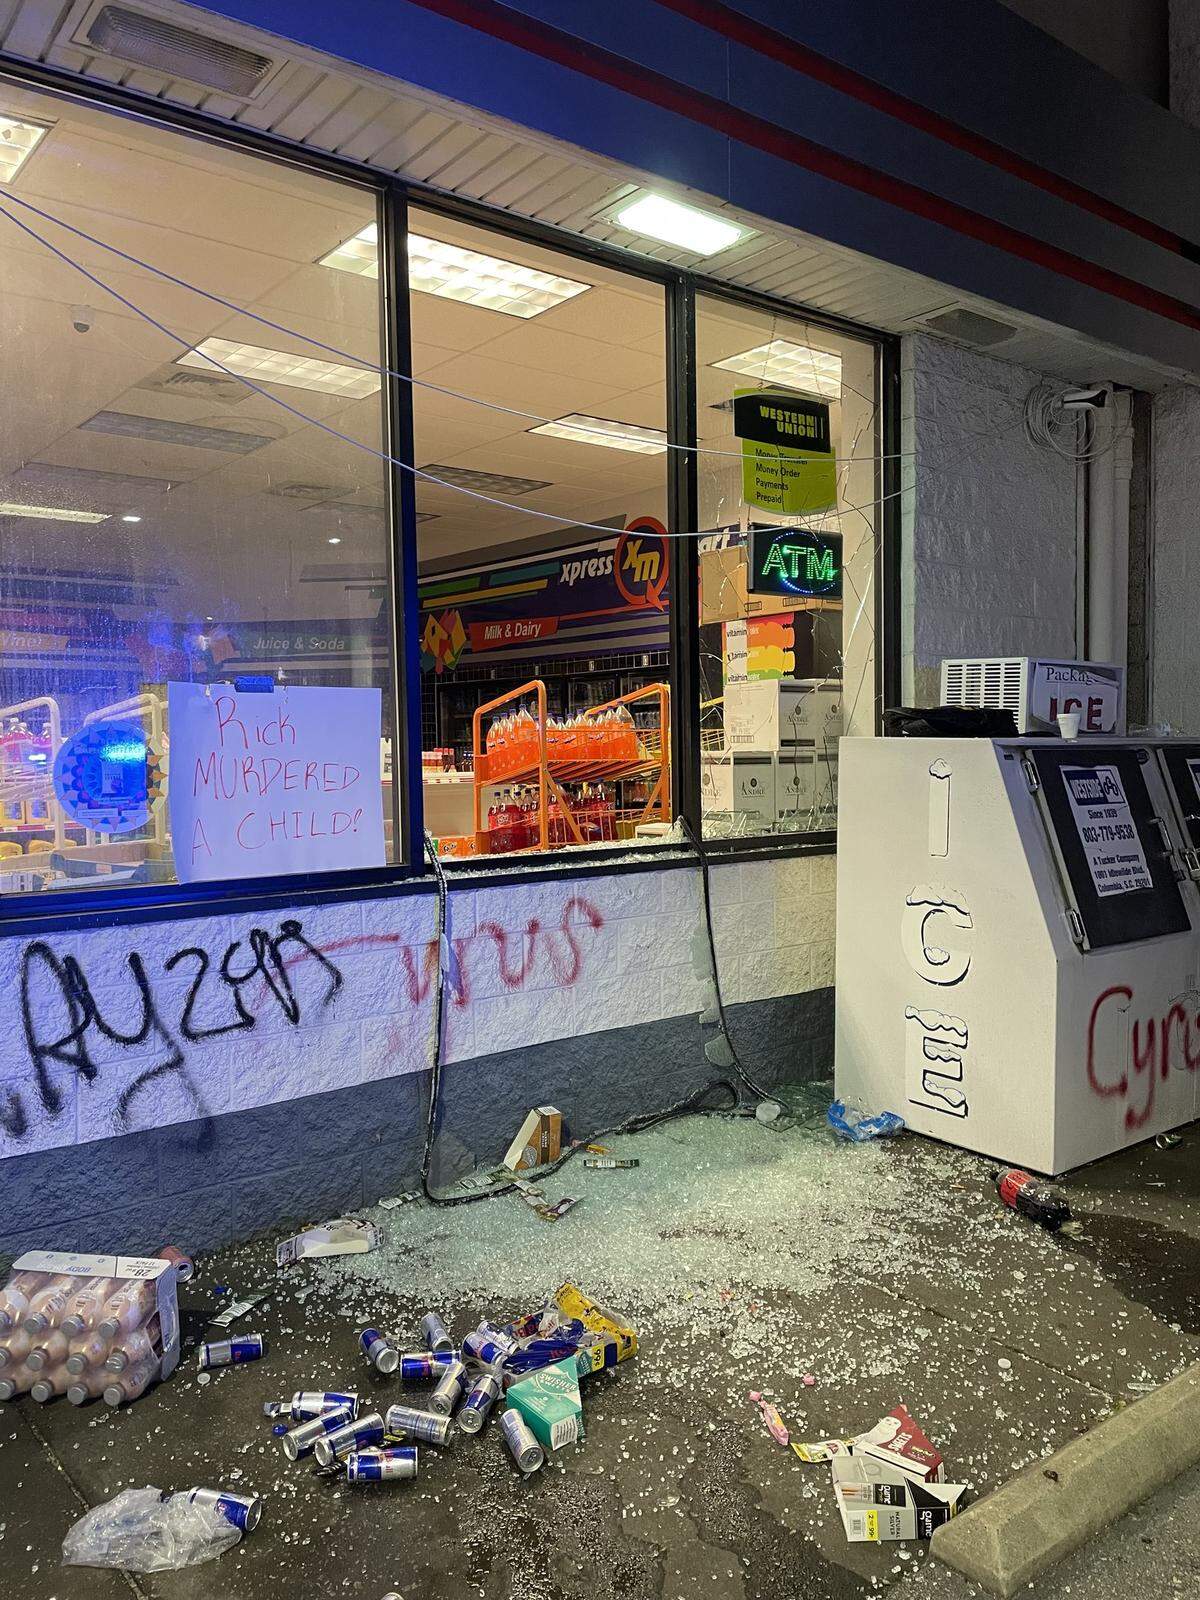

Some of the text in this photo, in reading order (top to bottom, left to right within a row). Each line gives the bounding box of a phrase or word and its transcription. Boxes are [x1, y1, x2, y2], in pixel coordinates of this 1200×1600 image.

[760, 405, 815, 427] WESTERN
[776, 420, 815, 438] UNION
[755, 462, 800, 478] Money Order
[755, 477, 789, 491] Payments
[756, 491, 782, 504] Prepaid
[560, 555, 614, 586] xpress
[762, 543, 834, 582] ATM
[484, 621, 541, 640] Milk & Dairy
[254, 636, 345, 650] Juice & Soda
[215, 696, 298, 749] Rick
[193, 752, 361, 800] MURDERED
[1087, 809, 1104, 820] Since
[191, 808, 363, 866] A CHILD!
